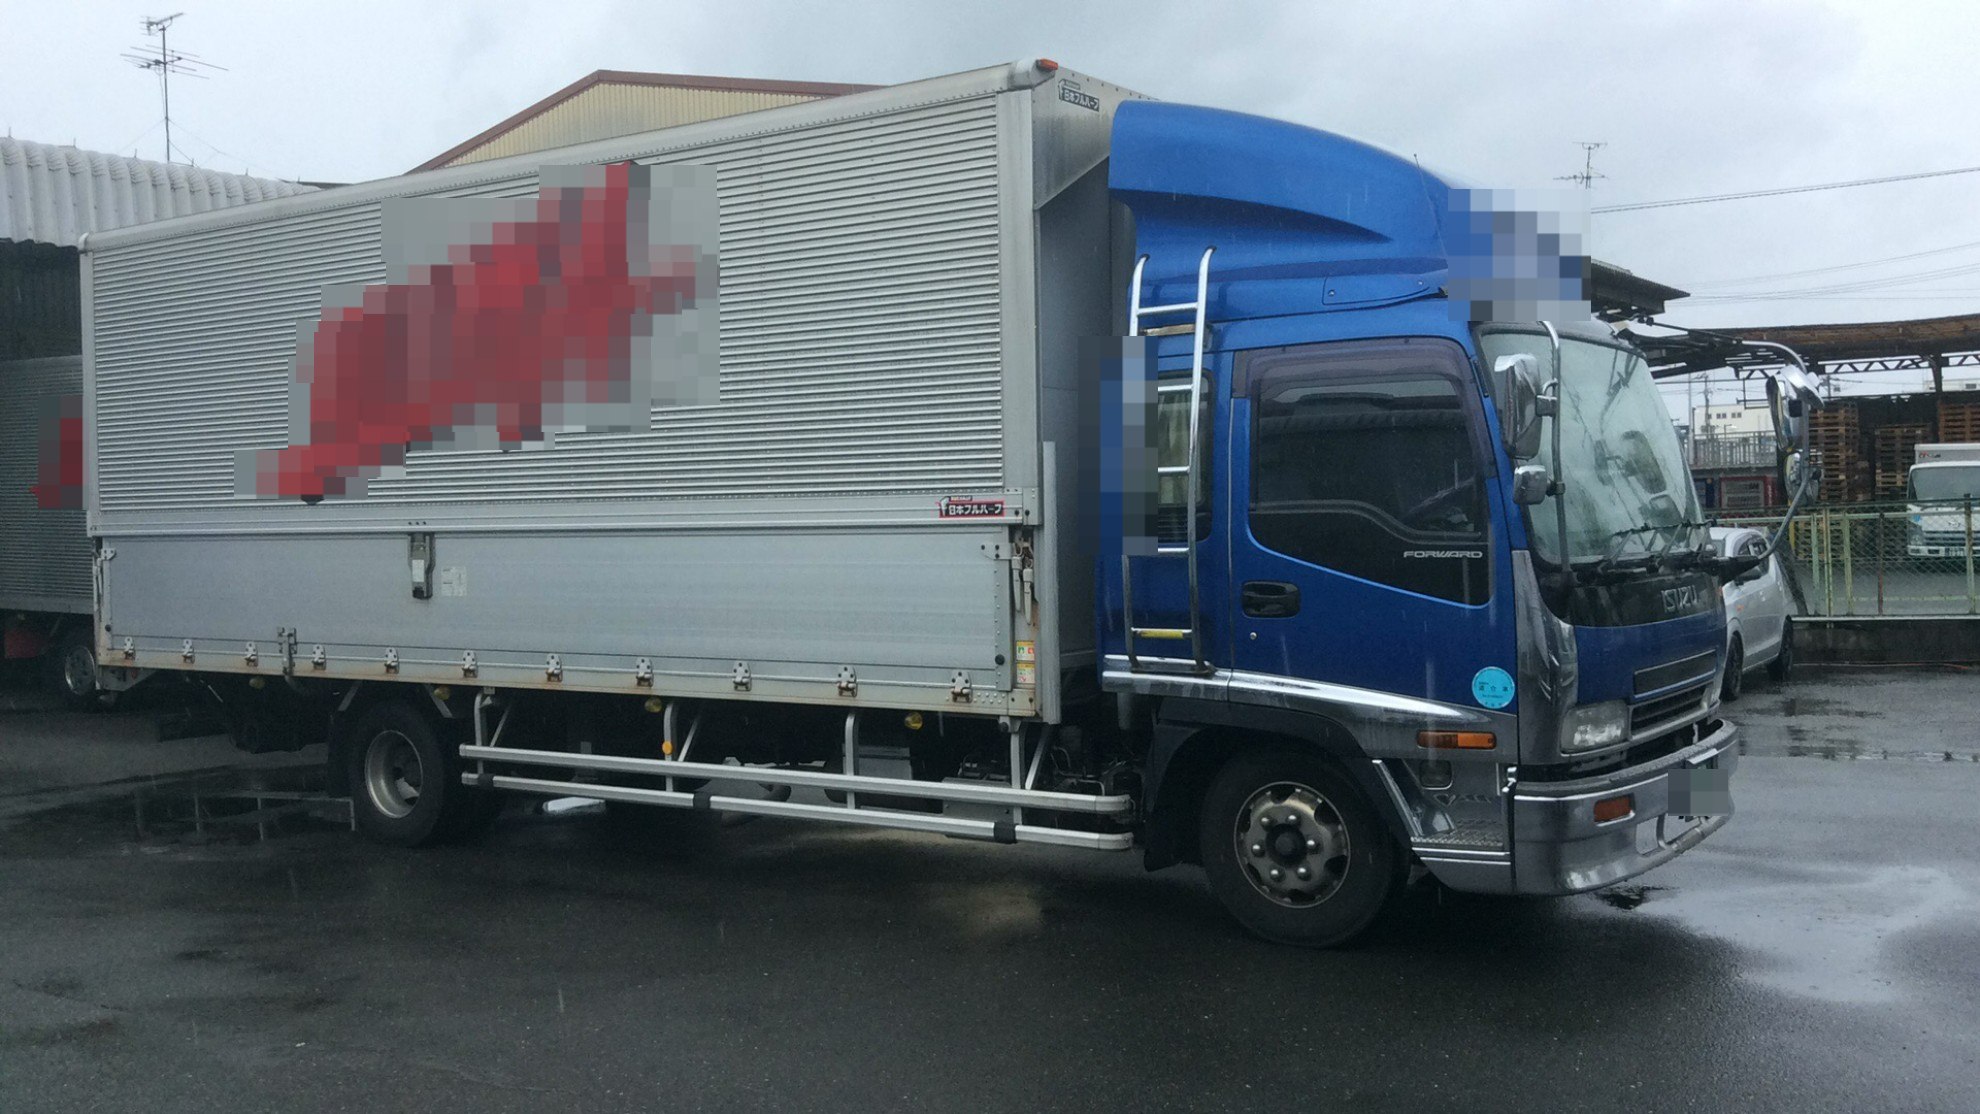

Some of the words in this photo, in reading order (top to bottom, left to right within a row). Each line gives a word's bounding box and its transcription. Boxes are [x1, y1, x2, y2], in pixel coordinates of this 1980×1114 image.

[948, 504, 1002, 516] 日本フルハーフ
[1403, 550, 1483, 558] FORWARD
[1660, 585, 1697, 613] ISUZU
